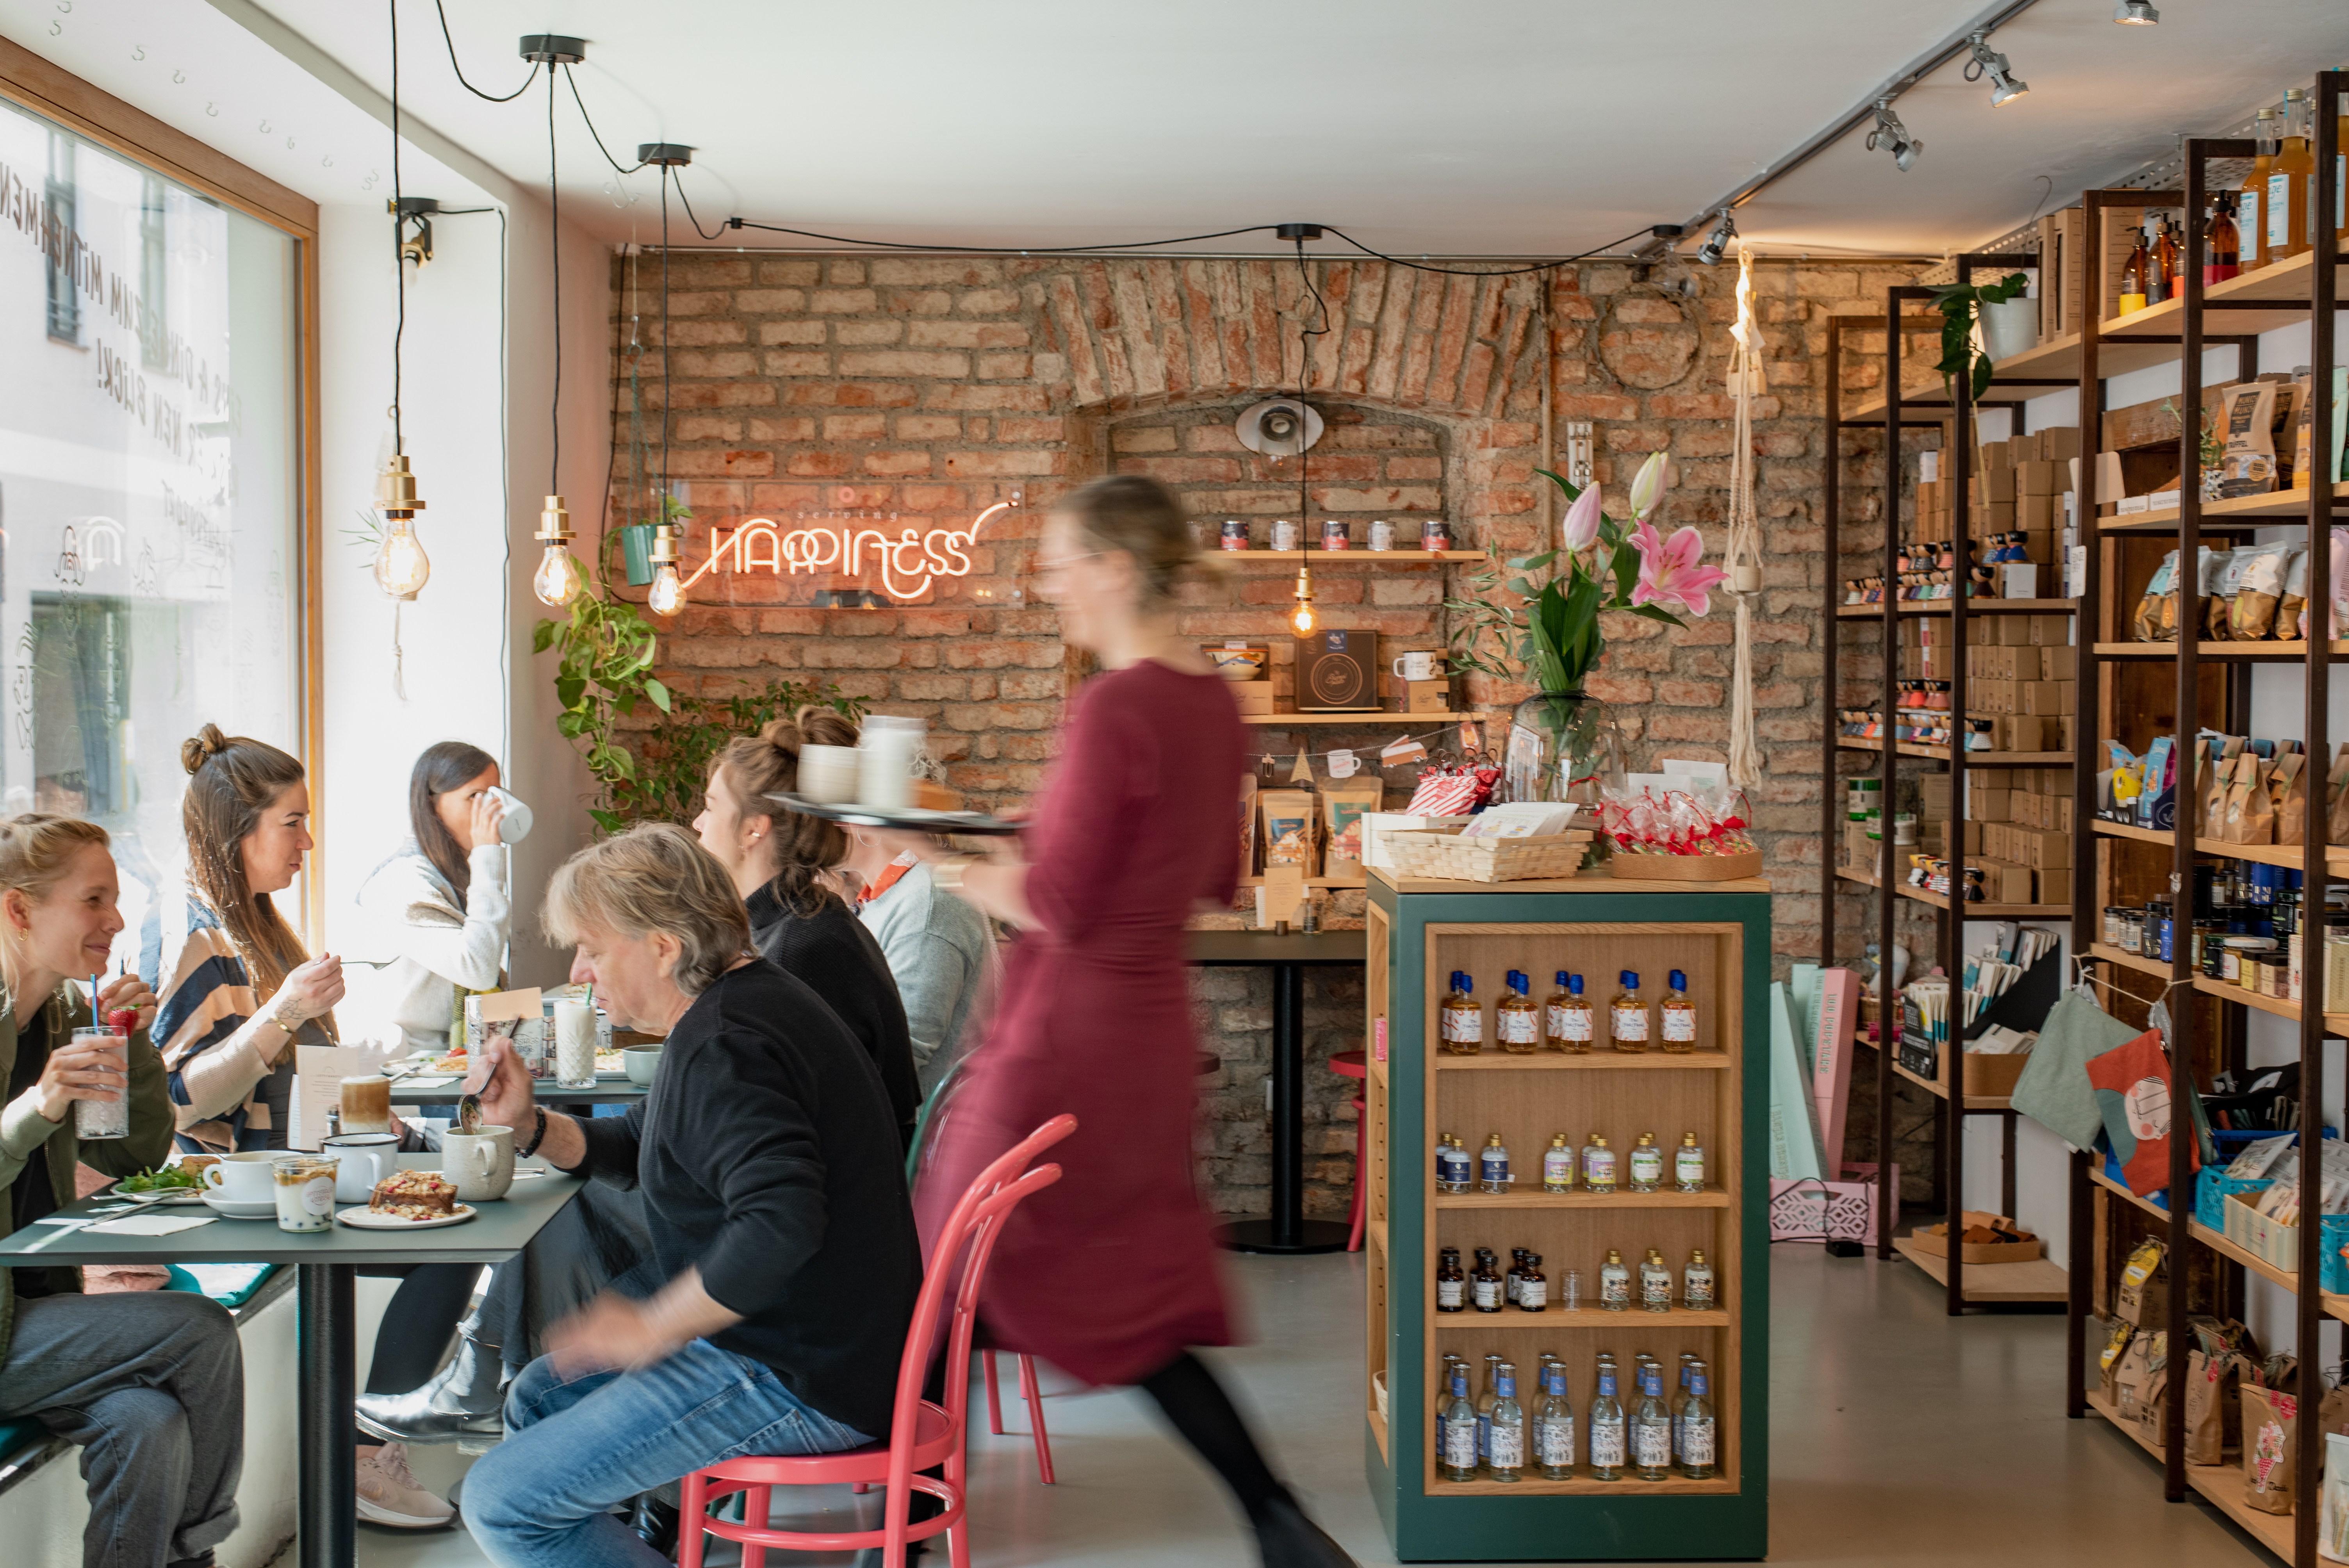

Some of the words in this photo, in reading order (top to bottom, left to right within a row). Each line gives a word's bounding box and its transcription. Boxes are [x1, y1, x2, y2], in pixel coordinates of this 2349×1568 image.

[797, 510, 898, 522] serving
[681, 501, 1018, 599] HAPPINESS
[1826, 994, 1837, 1013] 100
[1819, 1017, 1835, 1074] POPSTARS
